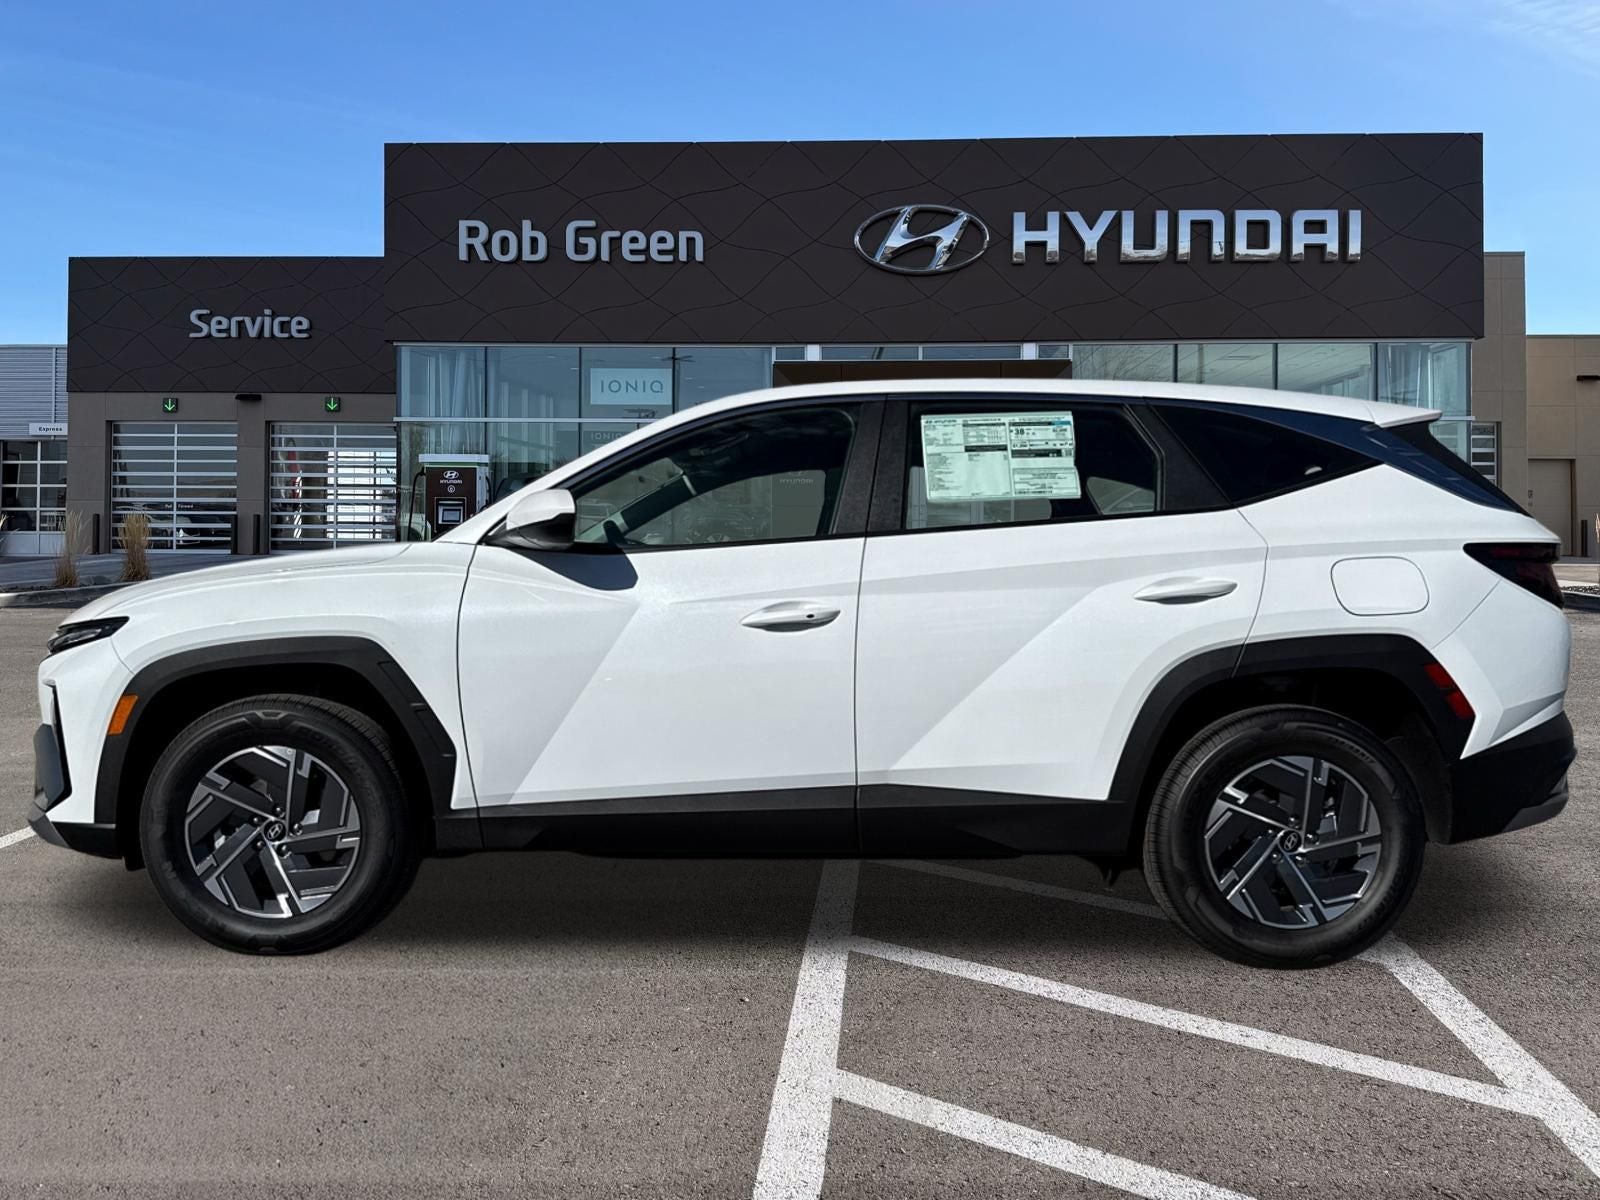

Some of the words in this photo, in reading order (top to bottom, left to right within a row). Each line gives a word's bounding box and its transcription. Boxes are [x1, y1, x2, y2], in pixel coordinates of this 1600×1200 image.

[457, 219, 548, 263] Rob
[565, 219, 705, 263] Green
[1011, 208, 1363, 264] HYUNDAI
[188, 308, 311, 340] Service
[601, 379, 664, 393] IONIQ
